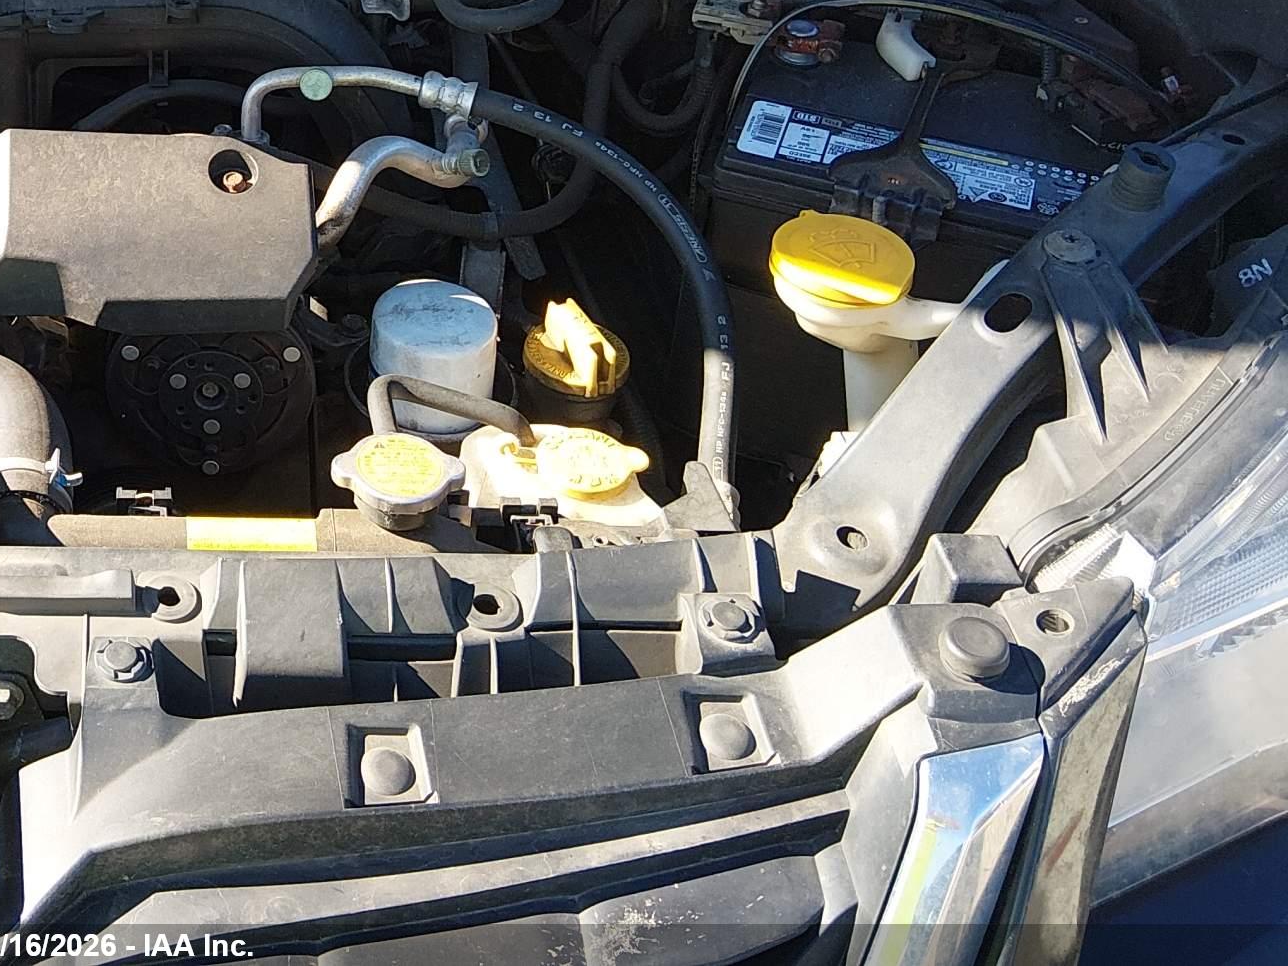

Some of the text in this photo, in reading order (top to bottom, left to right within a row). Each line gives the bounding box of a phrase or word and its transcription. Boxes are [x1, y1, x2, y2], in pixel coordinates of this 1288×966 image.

[513, 102, 524, 112] 2
[533, 111, 552, 123] 13
[717, 315, 727, 325] 2
[720, 334, 729, 349] 13
[721, 362, 731, 381] FJ
